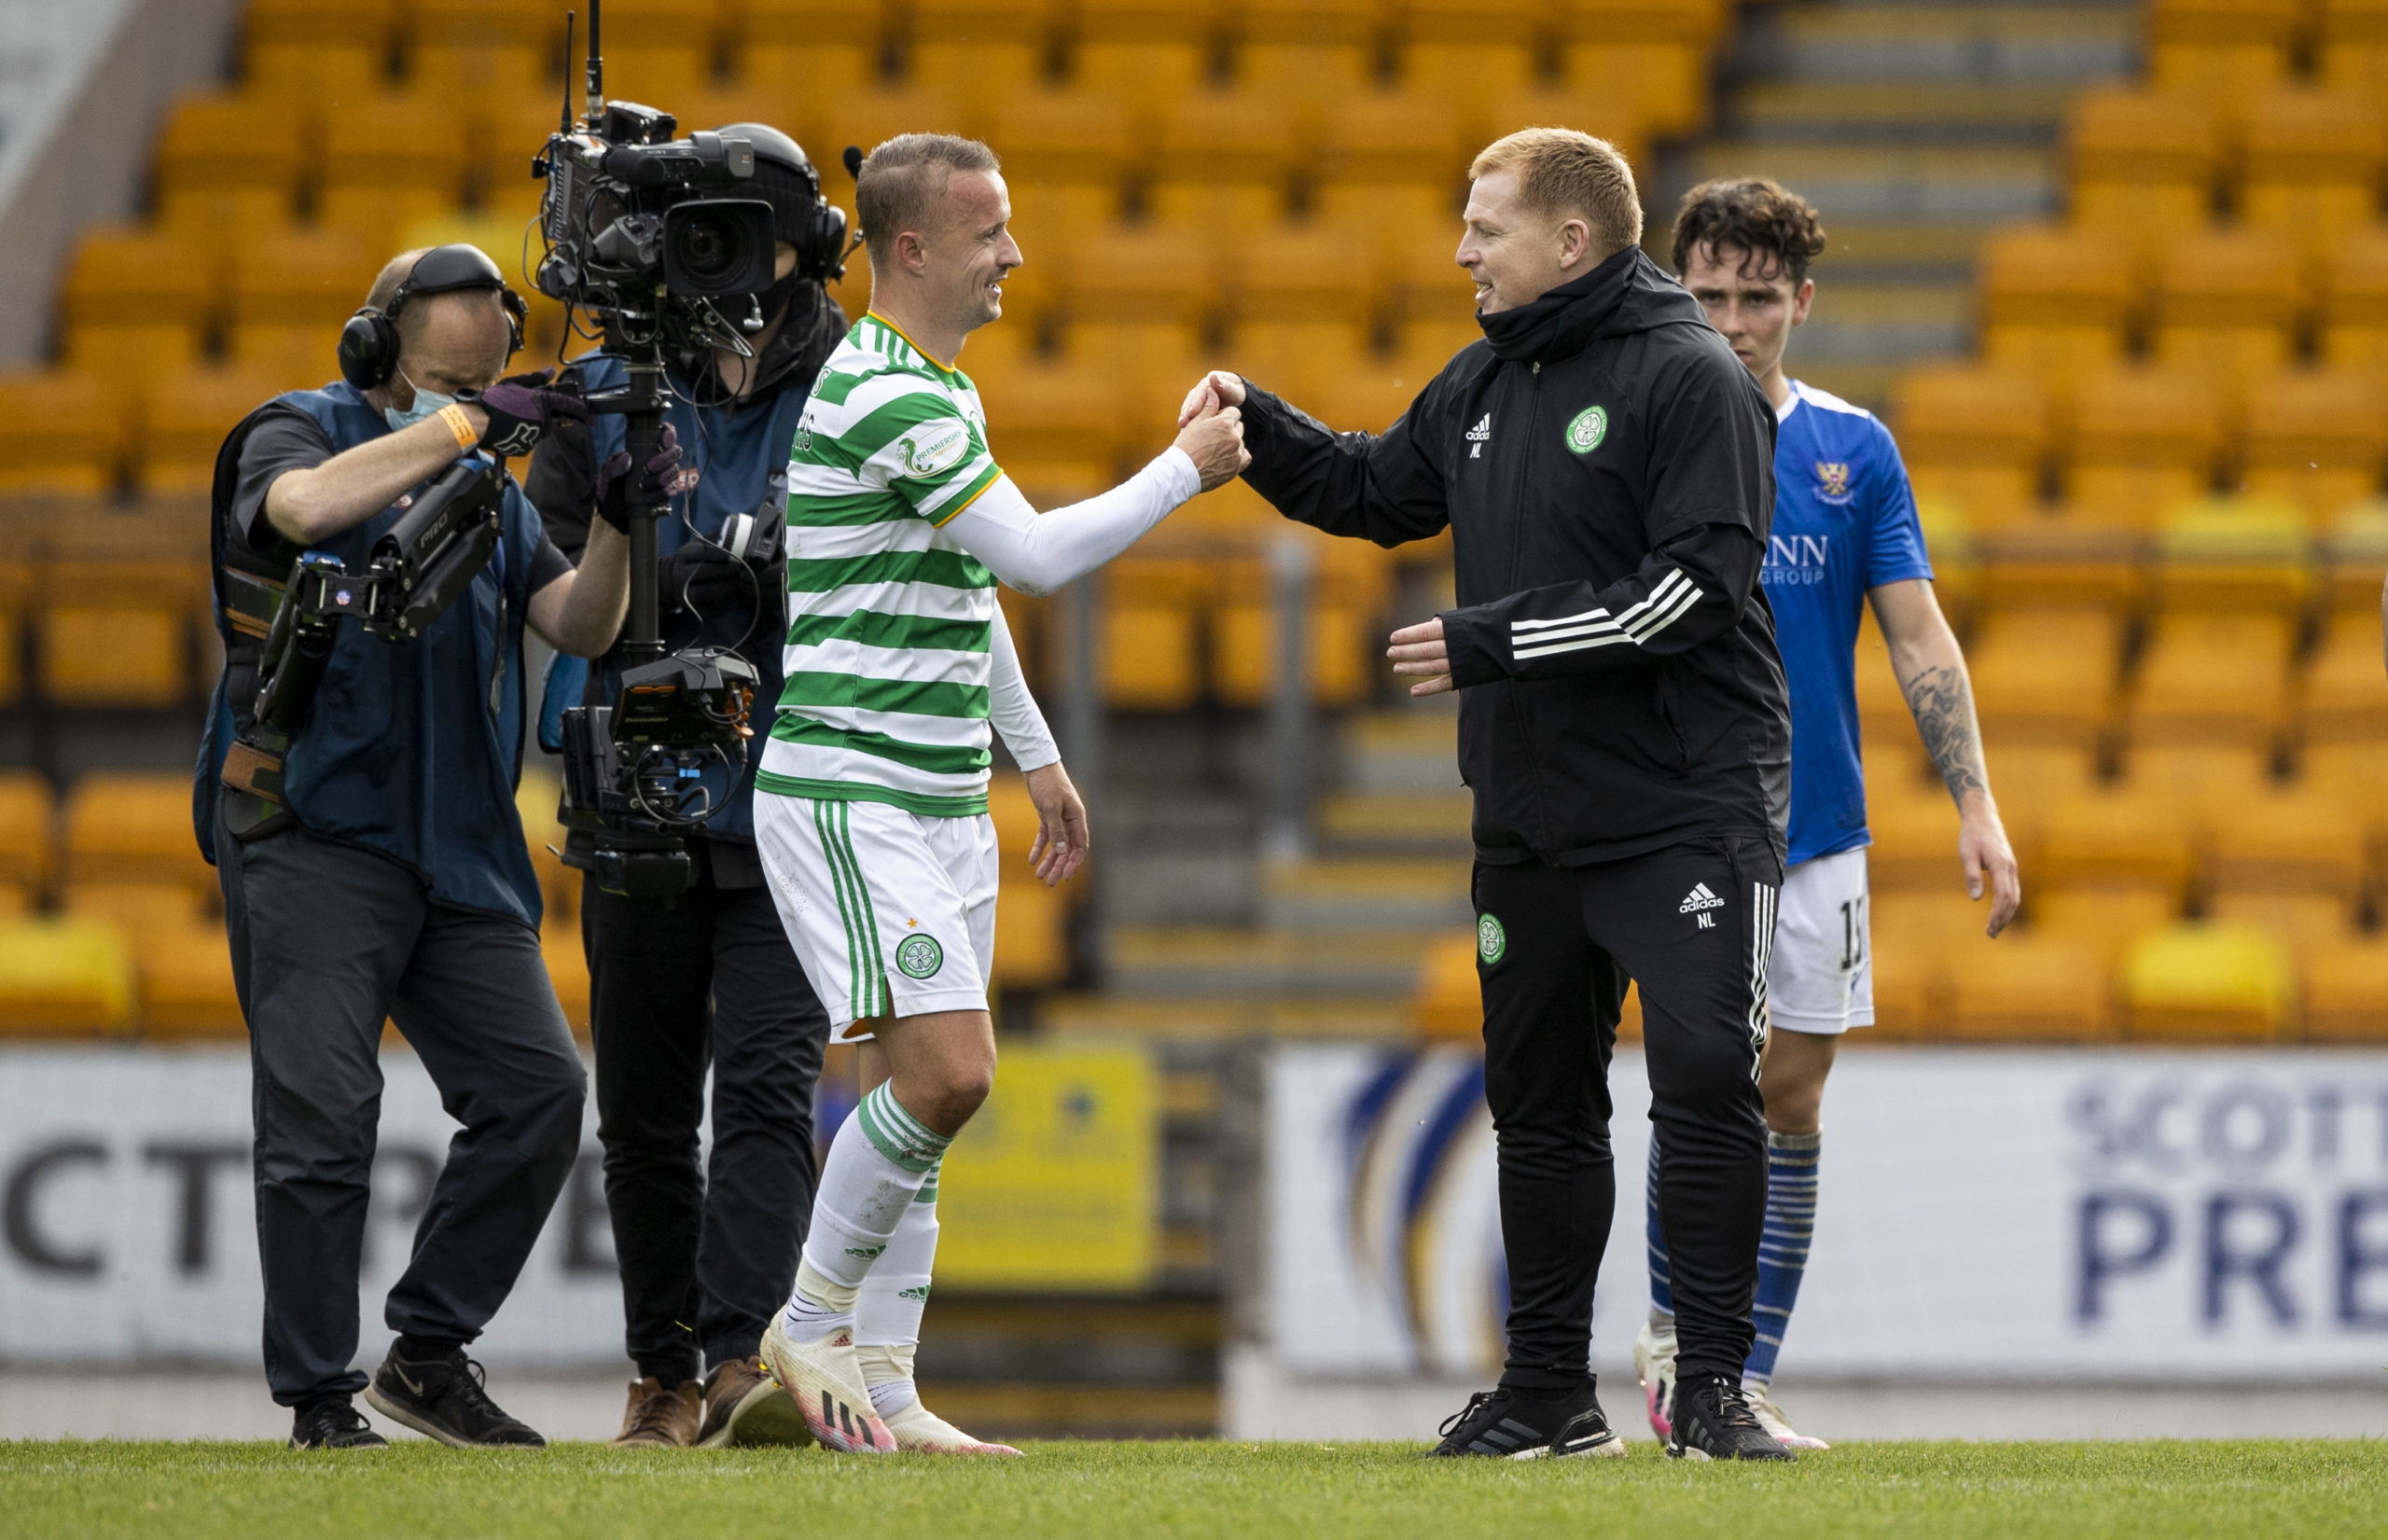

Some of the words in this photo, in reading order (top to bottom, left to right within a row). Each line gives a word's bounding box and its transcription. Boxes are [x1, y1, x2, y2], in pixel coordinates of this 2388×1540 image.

[1762, 534, 1829, 567] NN
[1679, 897, 1725, 913] adidas
[1697, 911, 1716, 929] NL
